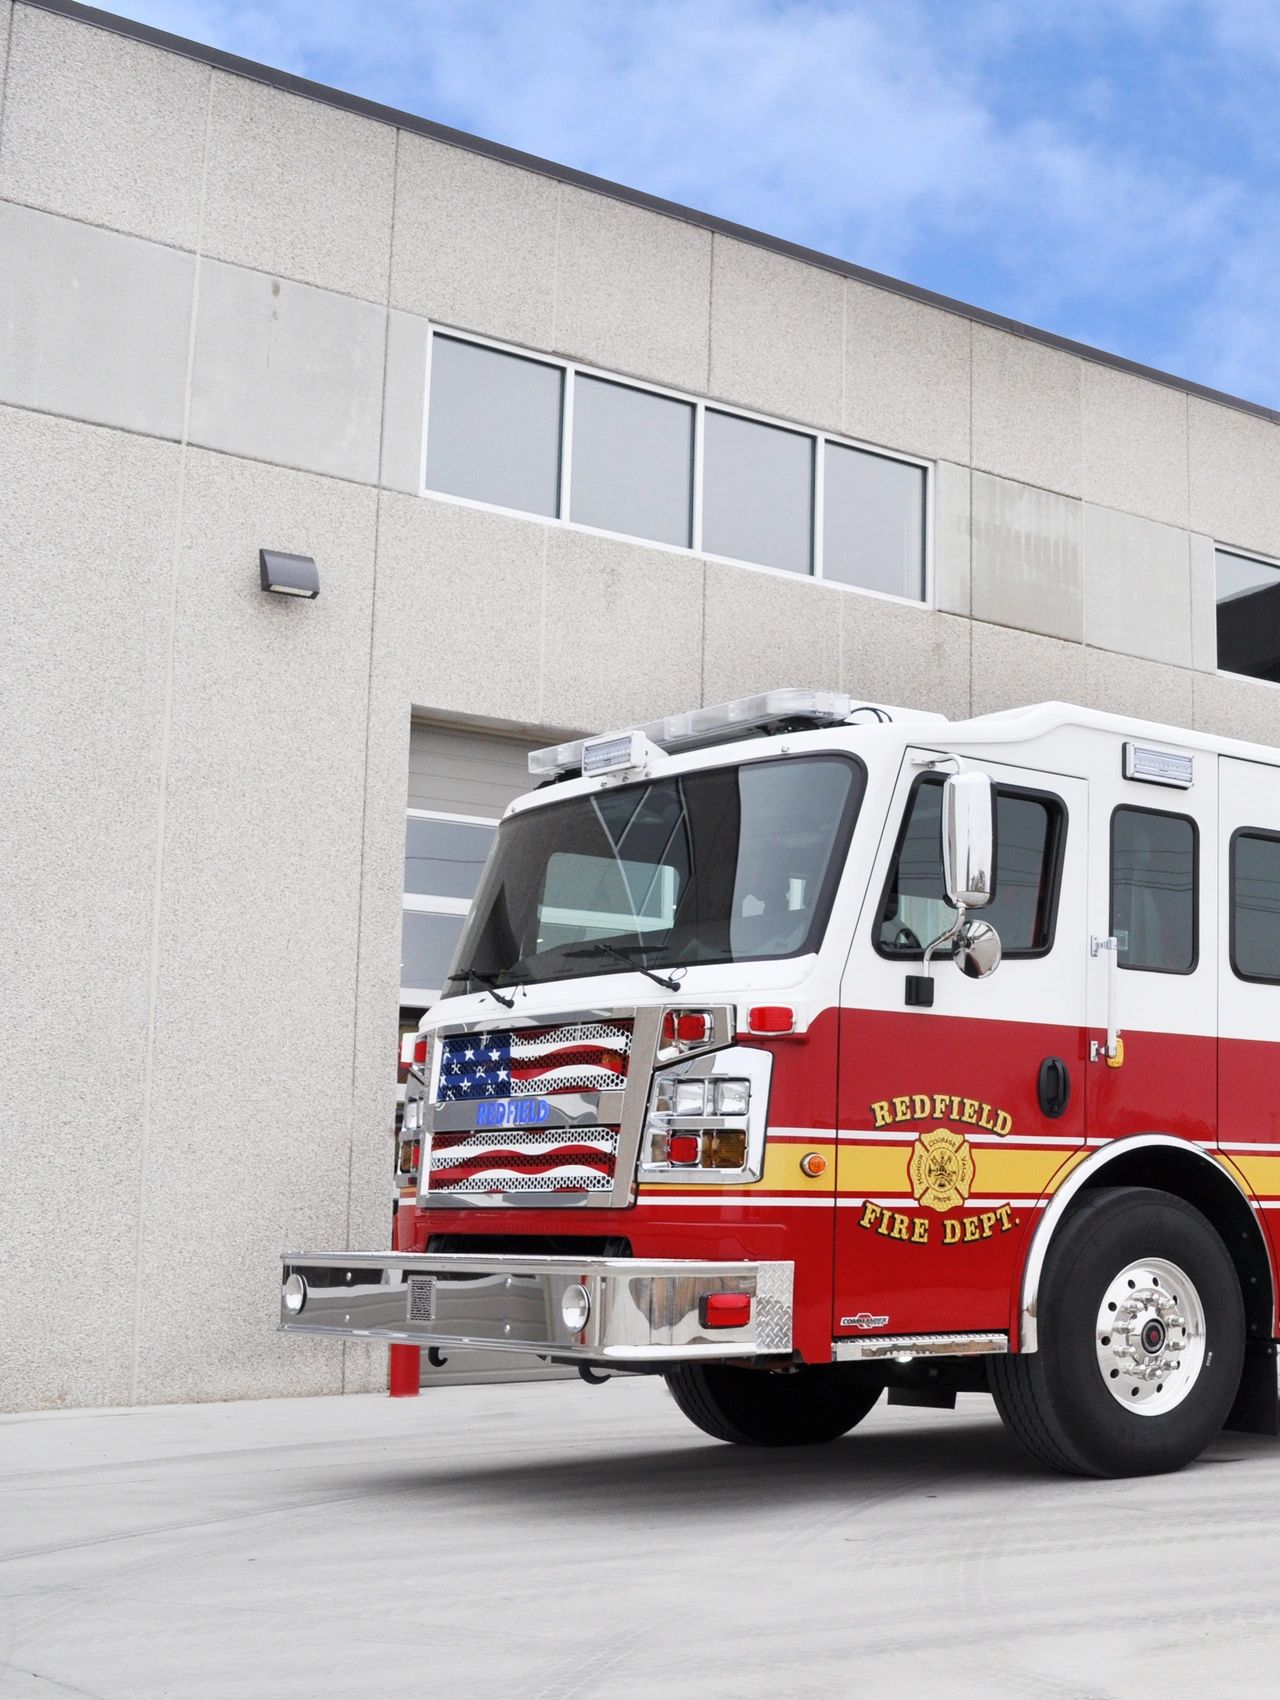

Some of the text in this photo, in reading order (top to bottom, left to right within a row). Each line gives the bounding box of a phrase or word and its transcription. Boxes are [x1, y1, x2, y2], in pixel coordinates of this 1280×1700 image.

[477, 1100, 550, 1126] REDFIELD
[871, 1094, 1013, 1137] REDFIELD
[859, 1201, 1020, 1245] FIRE DEPT.
